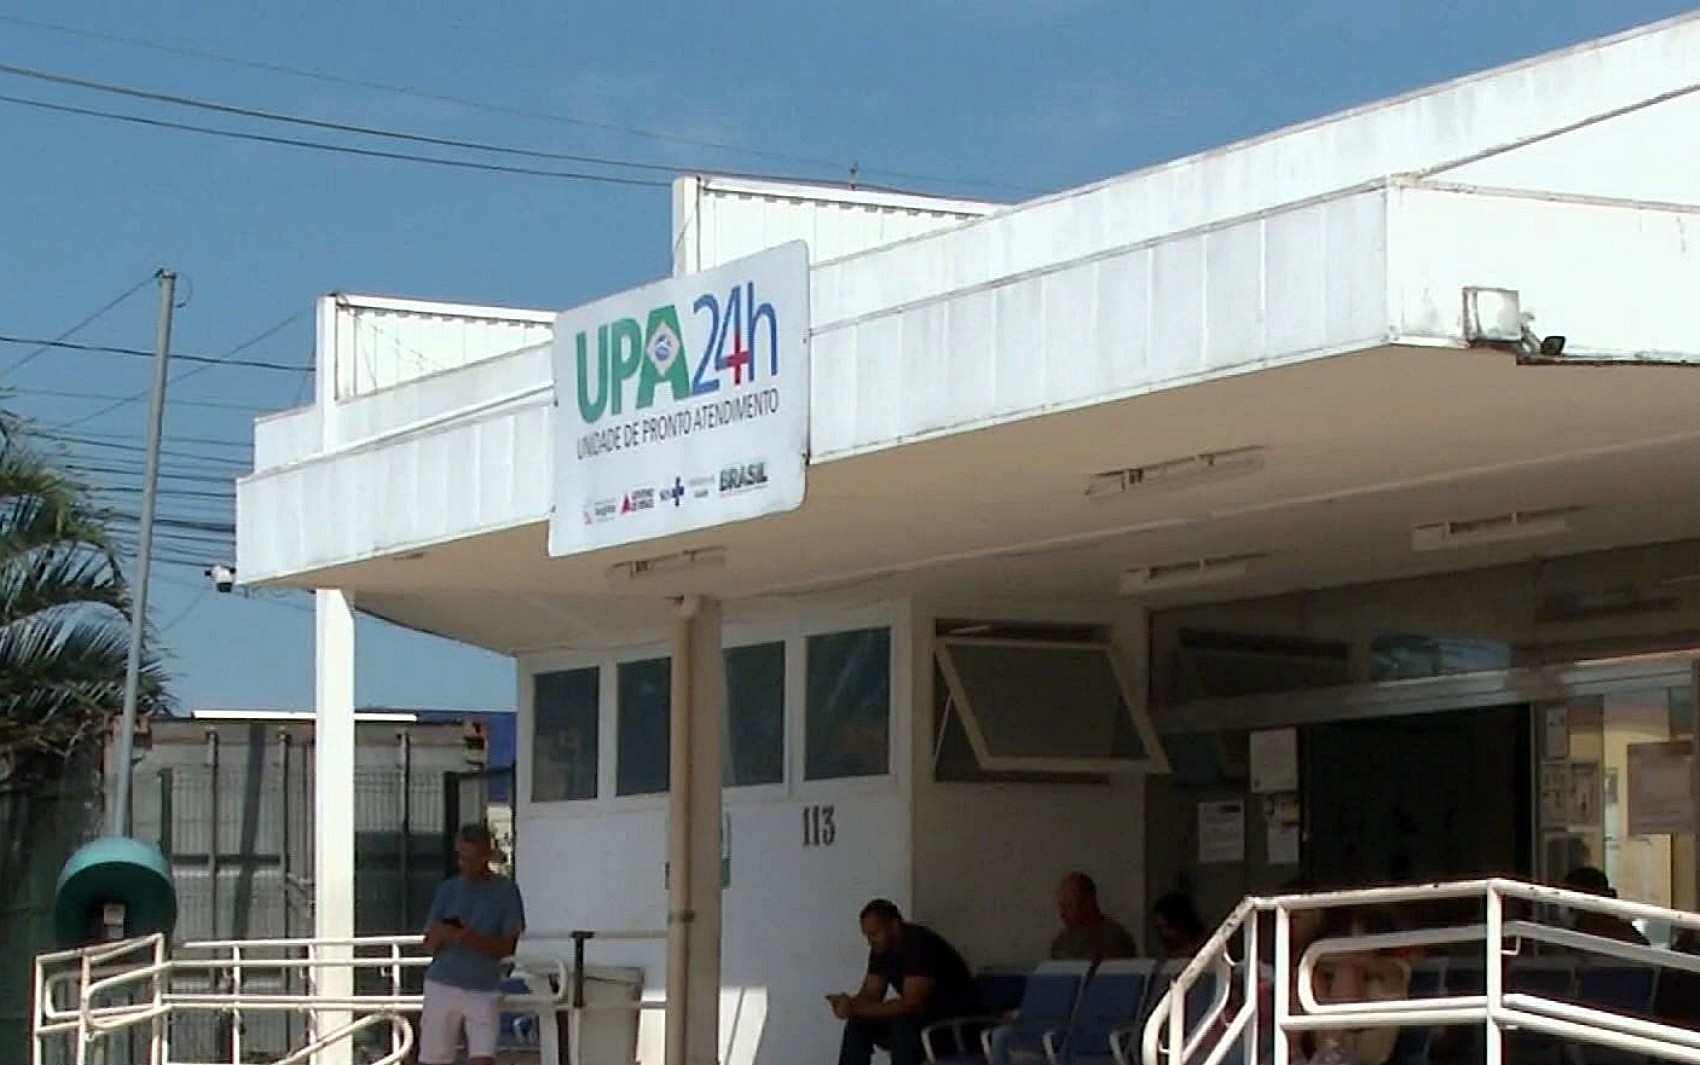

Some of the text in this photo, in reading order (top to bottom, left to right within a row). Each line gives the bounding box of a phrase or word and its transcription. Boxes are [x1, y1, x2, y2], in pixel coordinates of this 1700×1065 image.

[576, 281, 777, 423] UPA 24h
[577, 388, 780, 460] UNIDADE DE PRONTO ATENDIMENTO
[719, 462, 768, 491] BRASIL
[803, 805, 835, 846] 113
